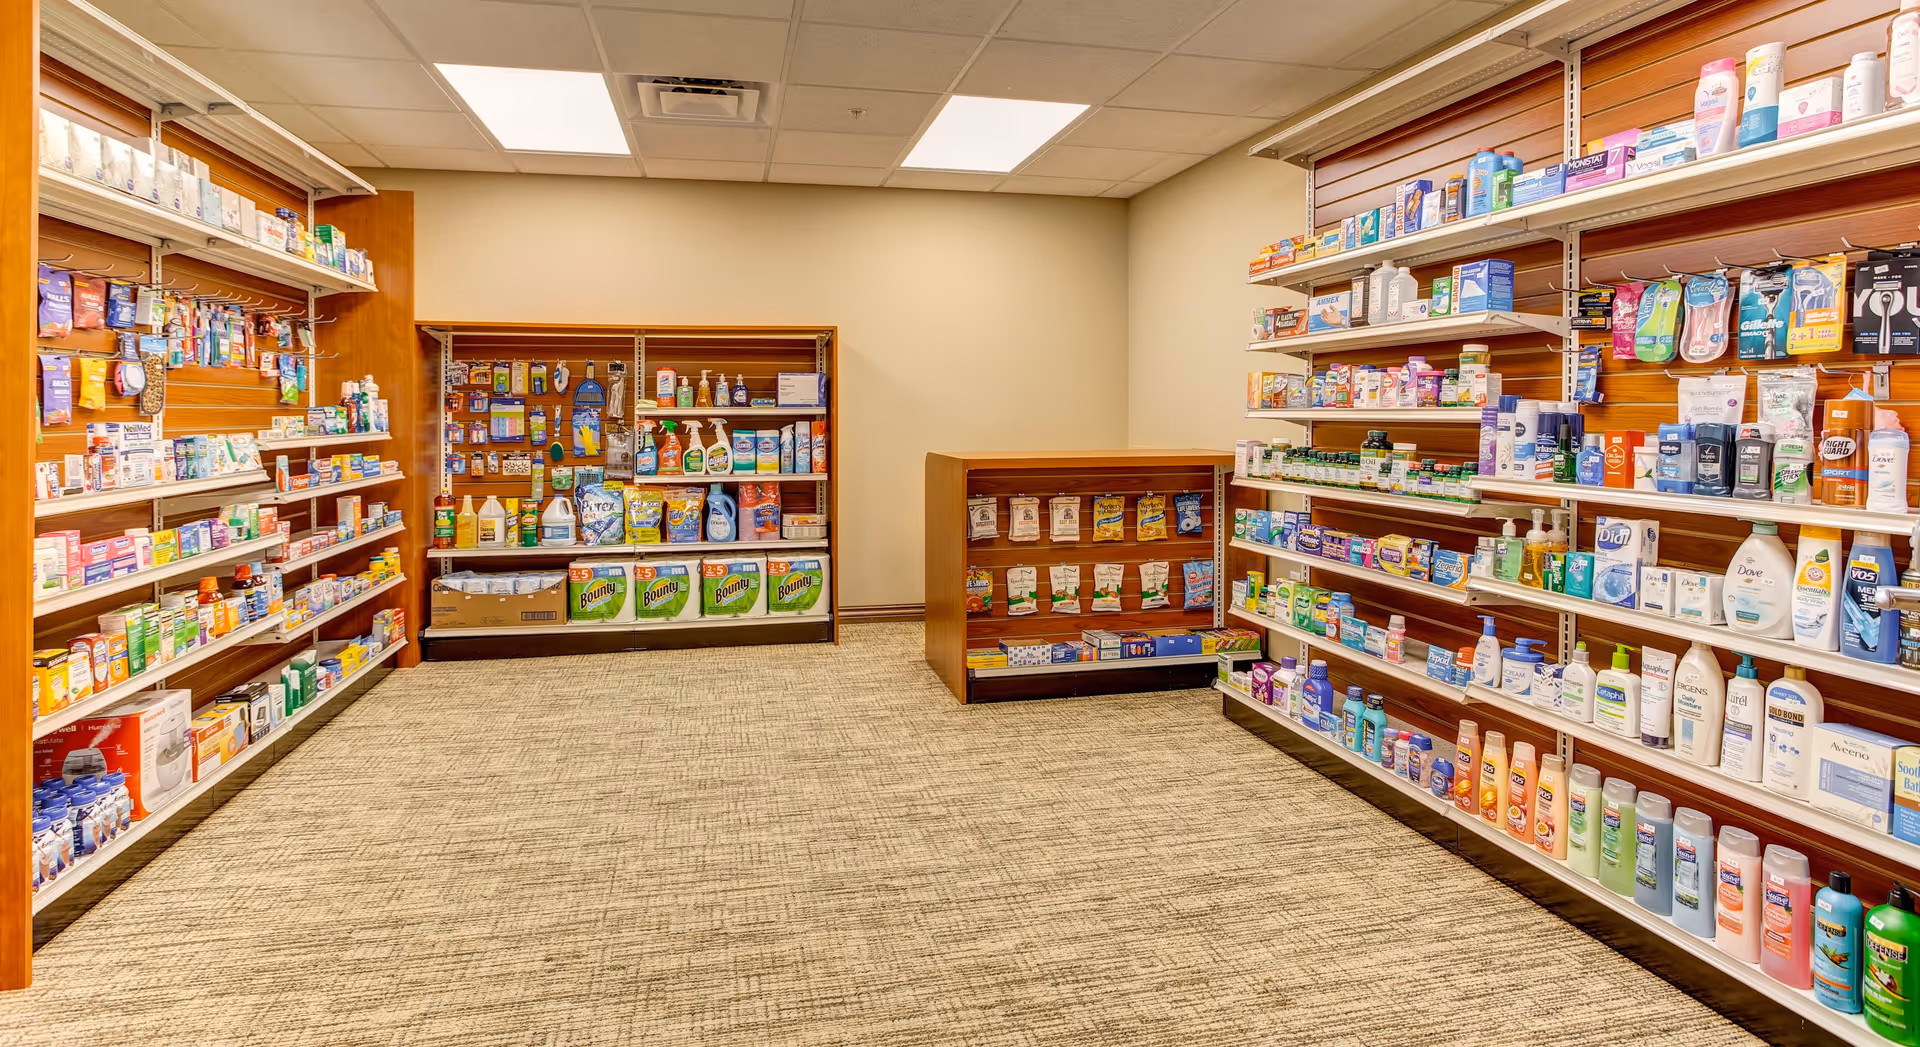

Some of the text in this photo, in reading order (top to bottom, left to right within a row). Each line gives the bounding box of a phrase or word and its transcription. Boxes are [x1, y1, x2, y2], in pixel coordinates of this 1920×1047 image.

[1568, 148, 1621, 171] MONISTAT 7
[1636, 158, 1661, 171] Vagisil
[1452, 267, 1460, 303] BAND-AID
[1316, 296, 1340, 306] AMMEX
[1638, 293, 1655, 322] Venus
[1740, 319, 1785, 331] Gillette
[123, 424, 152, 433] NeilMed
[1825, 440, 1851, 448] RIGHT
[1823, 447, 1851, 455] GUARD
[668, 509, 685, 520] Tide
[1299, 534, 1320, 545] Prilosec
[1600, 528, 1630, 546] Dial
[716, 565, 724, 575] 5
[779, 563, 786, 572] 5
[1436, 560, 1463, 572] Zegerid
[1737, 564, 1763, 578] Dove
[581, 569, 589, 579] 5
[644, 568, 652, 578] 5
[1645, 573, 1662, 581] Dove
[1851, 568, 1876, 582] VO5
[778, 575, 812, 601] Bounty
[1681, 578, 1699, 587] Dove
[580, 582, 616, 610] Bounty
[643, 580, 679, 607] Bounty
[715, 578, 750, 604] Bounty
[1796, 584, 1830, 595] Essentials
[1430, 652, 1450, 665] Pepcid
[1642, 662, 1670, 675] Aquaphor
[1597, 687, 1625, 702] Cetaphil
[1676, 680, 1708, 696] JERGENS
[1677, 699, 1702, 710] Moisture
[1681, 694, 1696, 703] Daily
[1769, 705, 1804, 722] GOLD BOND
[1829, 741, 1870, 761] Aveeno
[1677, 847, 1696, 860] Suave
[1720, 869, 1740, 882] Suave
[1766, 890, 1789, 904] Suave
[1817, 921, 1846, 937] DEFENSE
[1867, 938, 1907, 961] DEFENSE
